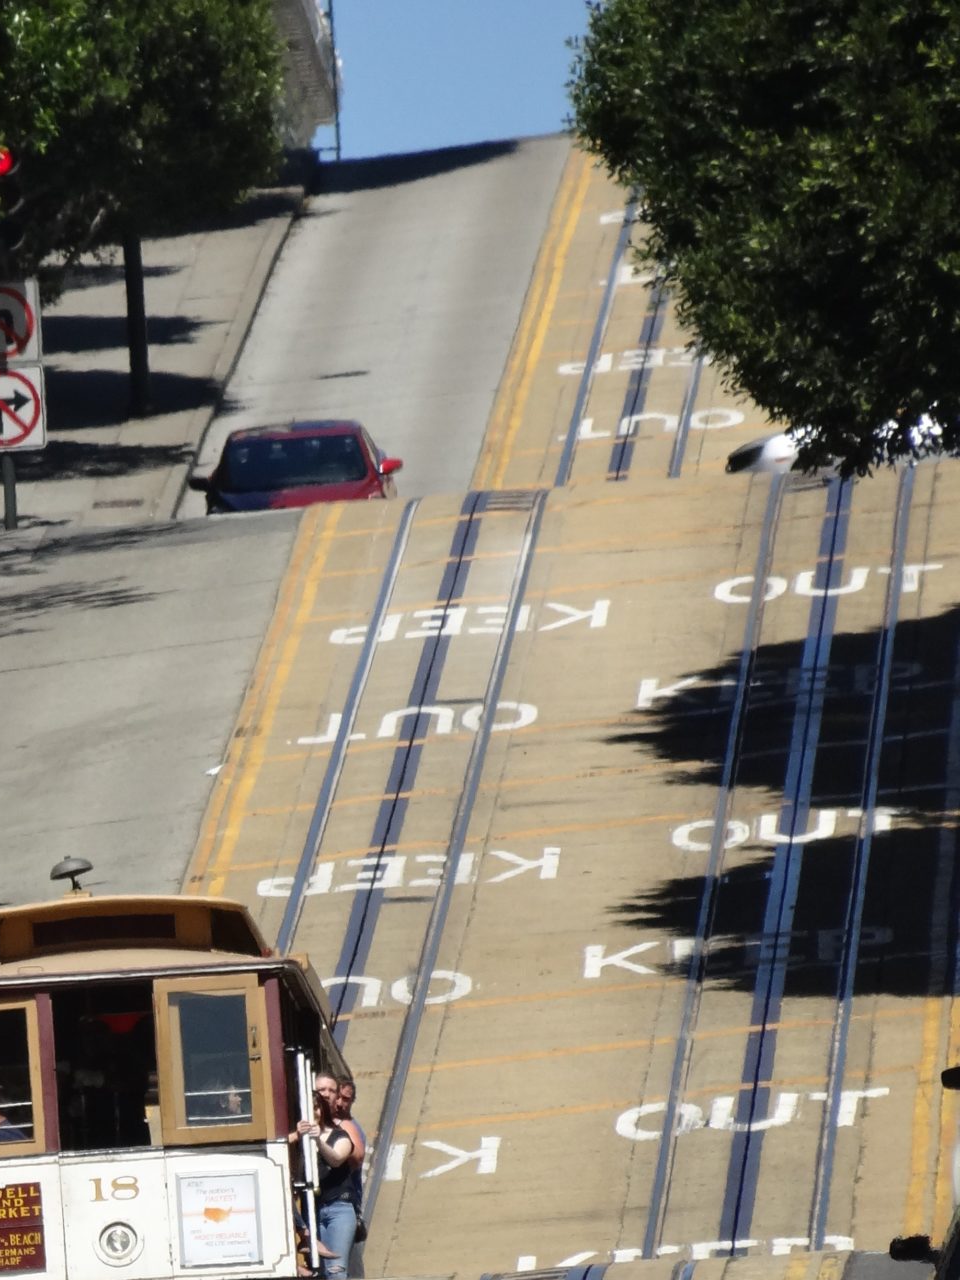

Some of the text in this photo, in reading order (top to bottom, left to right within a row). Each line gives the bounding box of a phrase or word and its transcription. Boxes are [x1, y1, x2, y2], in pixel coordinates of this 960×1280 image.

[558, 407, 745, 442] OUT
[714, 562, 944, 604] OUT
[329, 598, 611, 646] KEEP
[286, 700, 538, 745] OUT
[671, 806, 904, 852] OUT
[257, 846, 561, 898] KEEP
[321, 969, 473, 1007] OU
[615, 1087, 889, 1142] OUT
[88, 1175, 140, 1202] 18
[9, 1232, 41, 1246] BEACH
